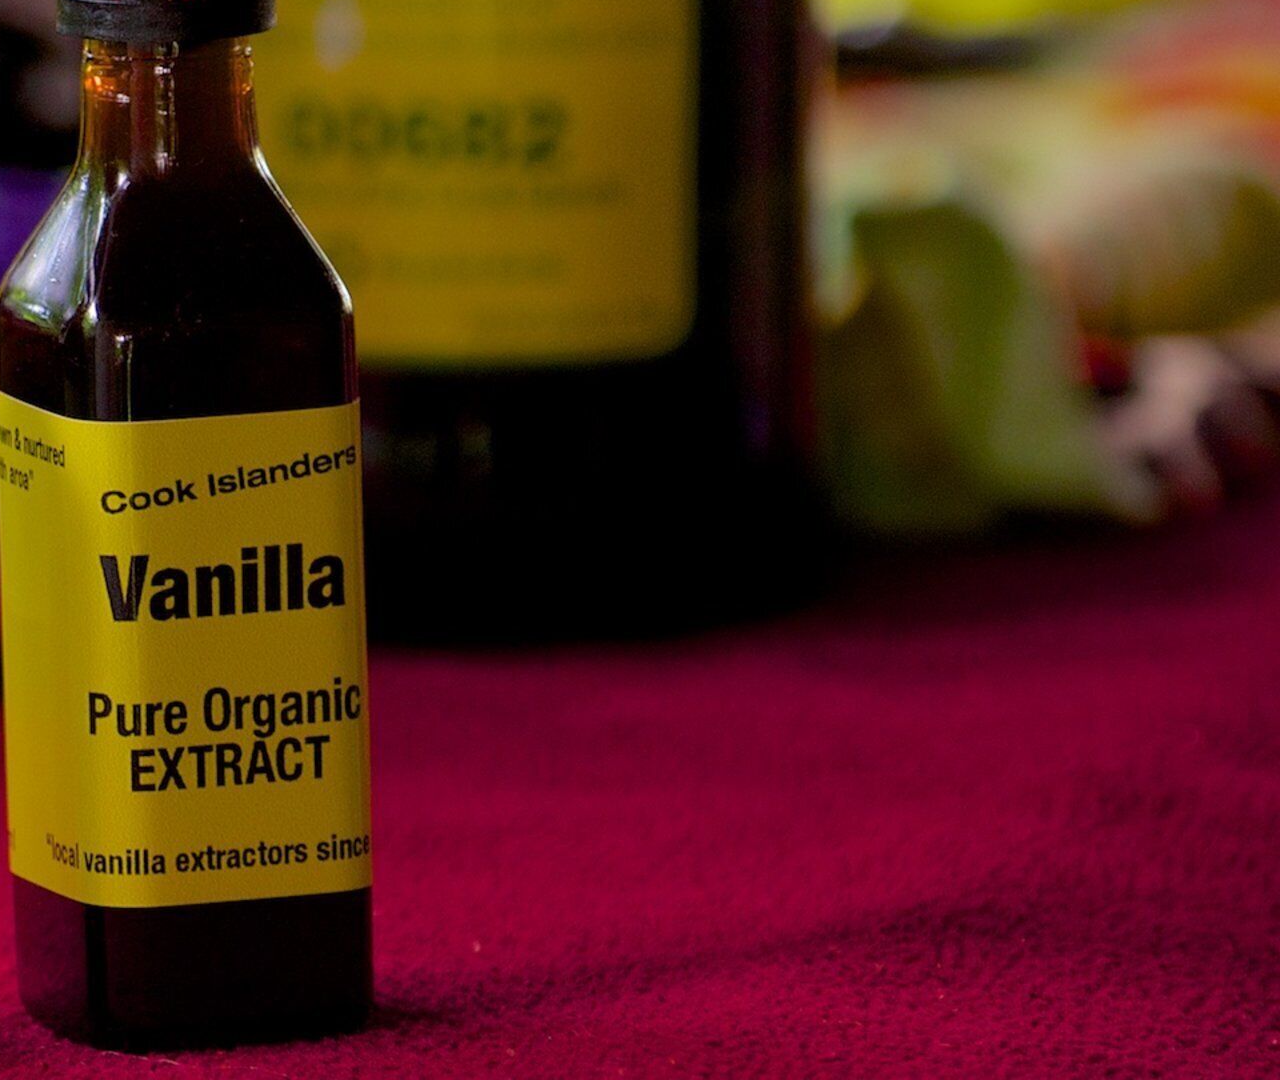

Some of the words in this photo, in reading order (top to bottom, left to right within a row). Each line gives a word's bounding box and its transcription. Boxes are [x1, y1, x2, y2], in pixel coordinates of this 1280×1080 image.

[23, 436, 65, 468] nurtured
[100, 479, 197, 515] Cook
[208, 445, 356, 496] Islanders
[99, 543, 345, 622] Vanilla
[89, 691, 187, 737] Pure
[203, 677, 361, 738] Organic
[130, 735, 330, 792] EXTRACT
[84, 849, 165, 875] vanilla
[176, 839, 308, 872] extractors
[317, 834, 371, 861] since
